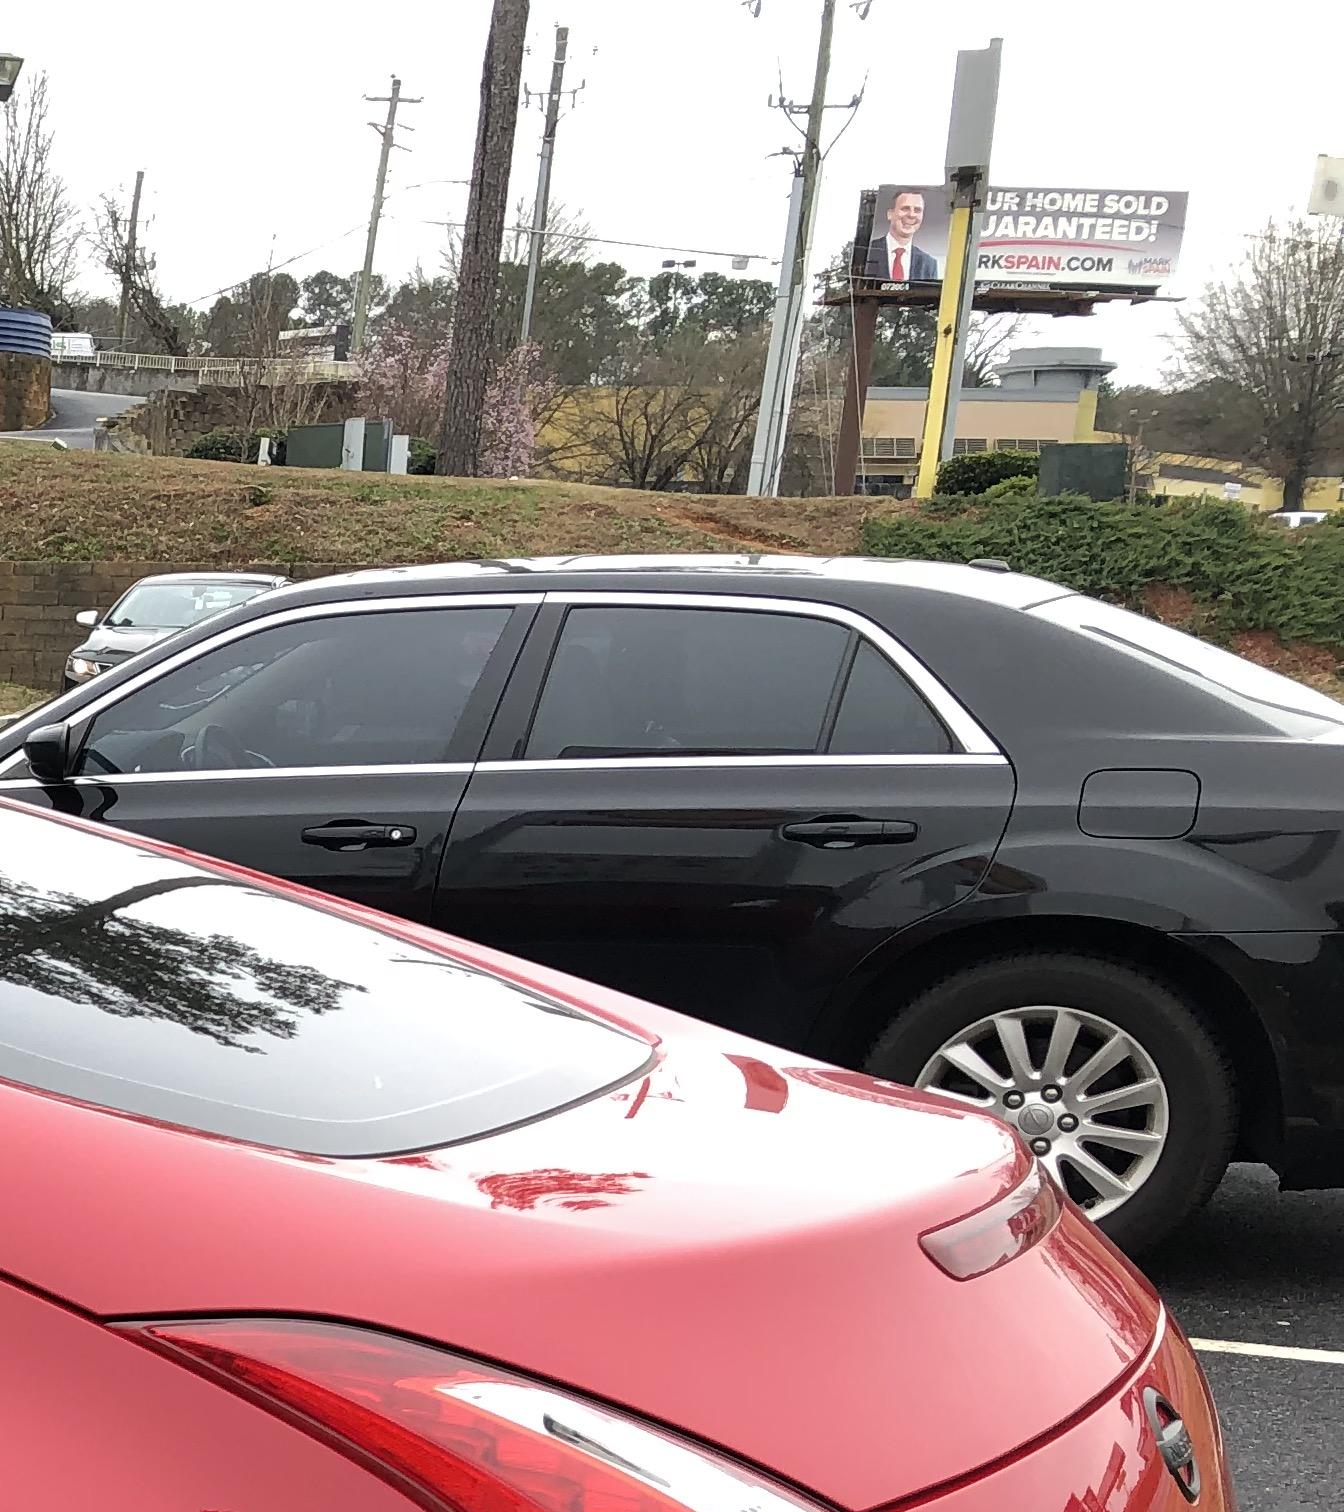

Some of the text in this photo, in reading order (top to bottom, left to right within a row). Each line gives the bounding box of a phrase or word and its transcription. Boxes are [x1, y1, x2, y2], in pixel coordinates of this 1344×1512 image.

[1025, 192, 1100, 213] HOME
[1103, 195, 1170, 216] SOLD
[978, 254, 1114, 273] RKSPAIN.COM
